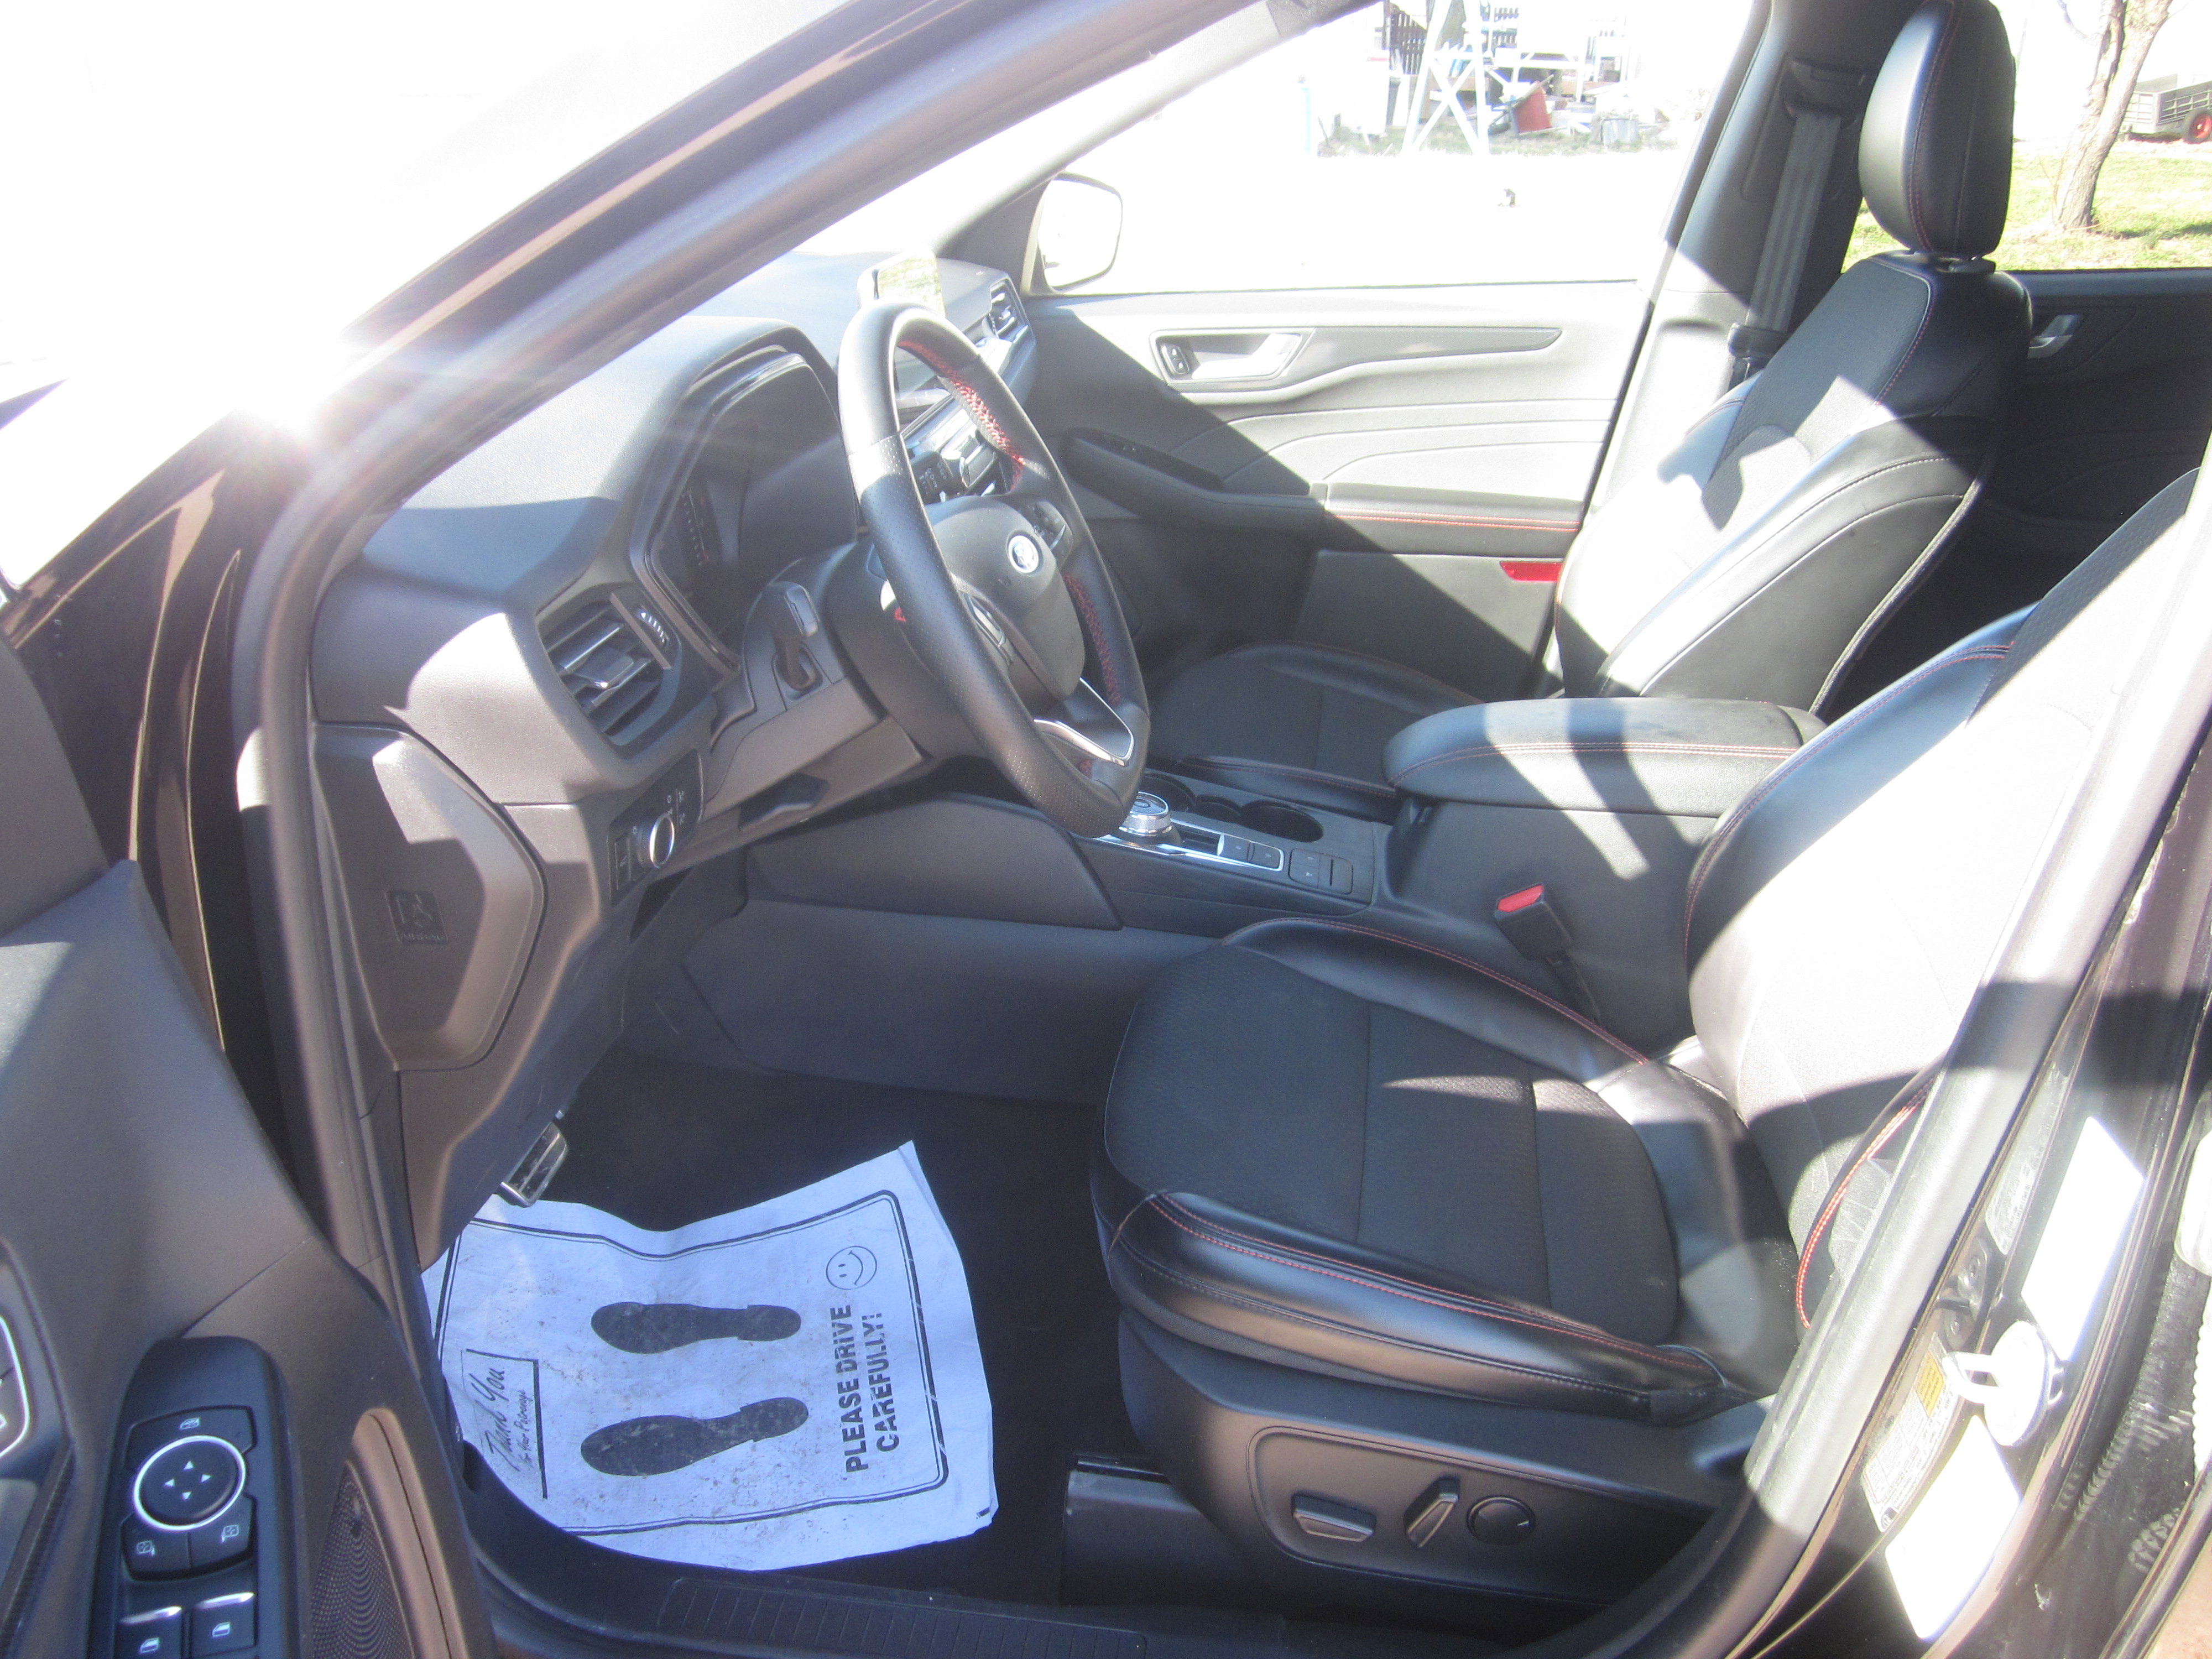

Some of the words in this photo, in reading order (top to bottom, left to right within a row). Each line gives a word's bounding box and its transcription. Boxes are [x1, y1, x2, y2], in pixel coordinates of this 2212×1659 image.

[830, 1305, 858, 1374] DRIVE
[469, 1368, 509, 1401] You
[862, 1313, 899, 1452] CAREFULLY!
[474, 1400, 520, 1472] Thank
[837, 1378, 869, 1472] PLEASE
